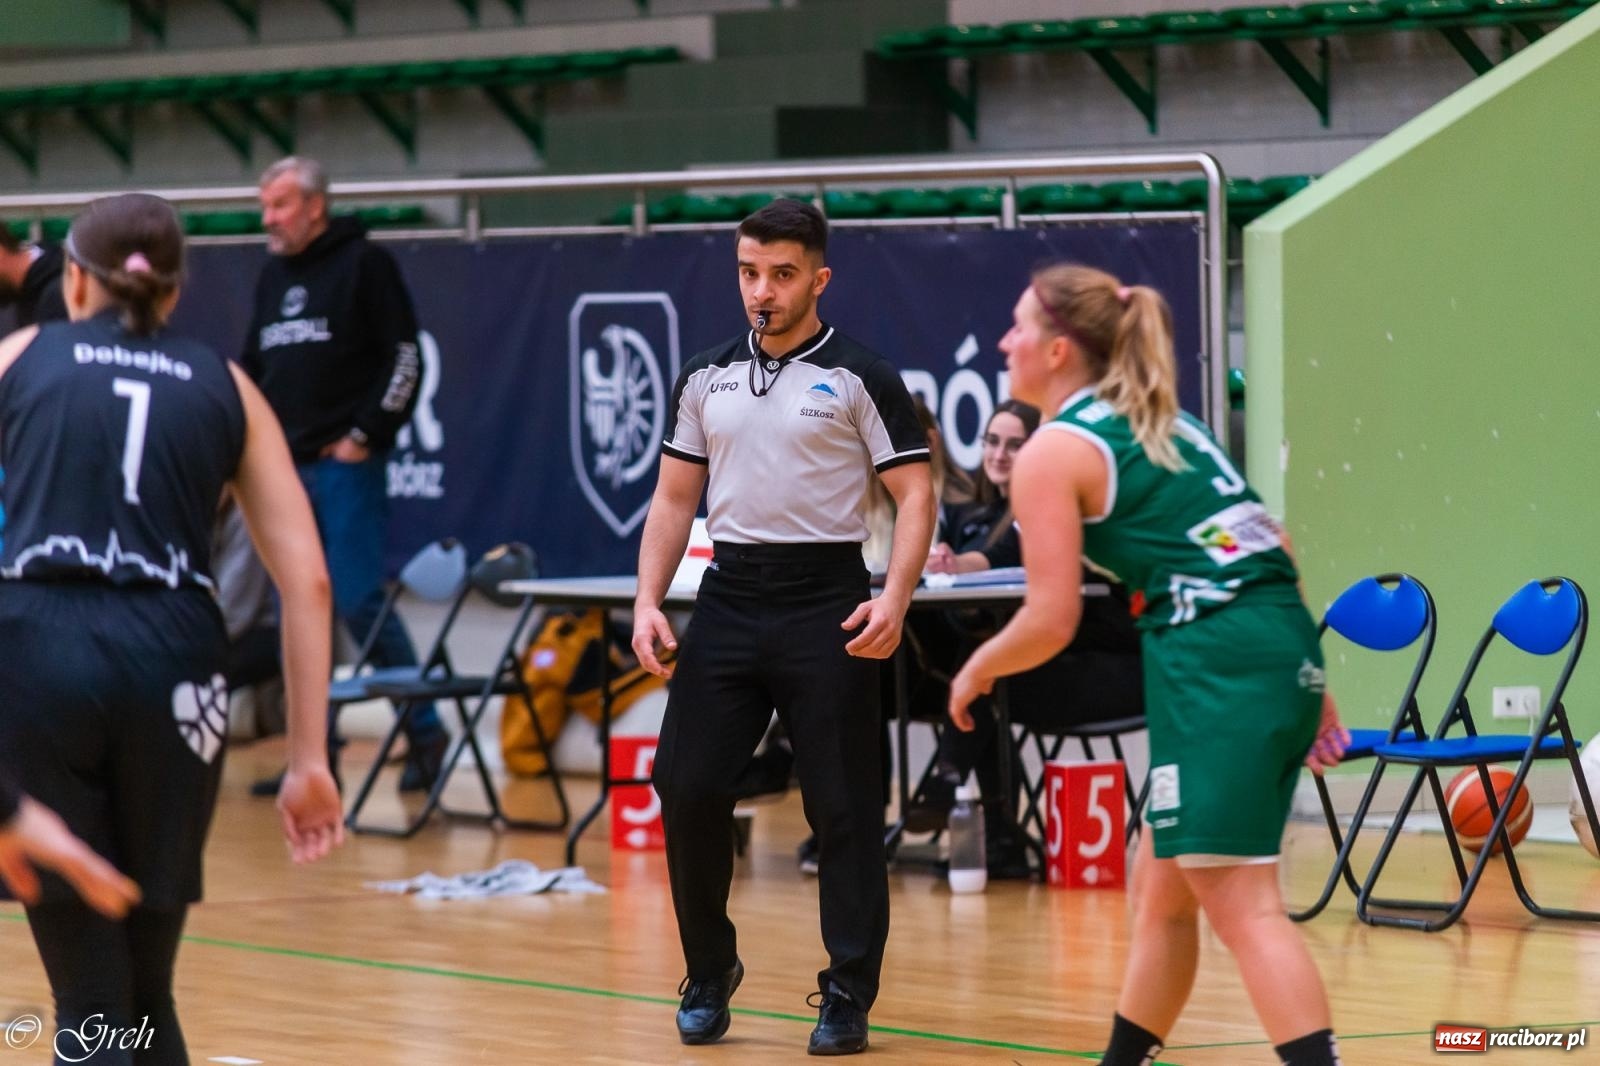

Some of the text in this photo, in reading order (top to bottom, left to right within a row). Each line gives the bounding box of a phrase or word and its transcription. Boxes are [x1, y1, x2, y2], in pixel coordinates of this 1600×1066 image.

[73, 342, 193, 381] Dobejko
[112, 376, 151, 505] 7
[620, 745, 662, 824] 5
[1078, 774, 1115, 859] 5
